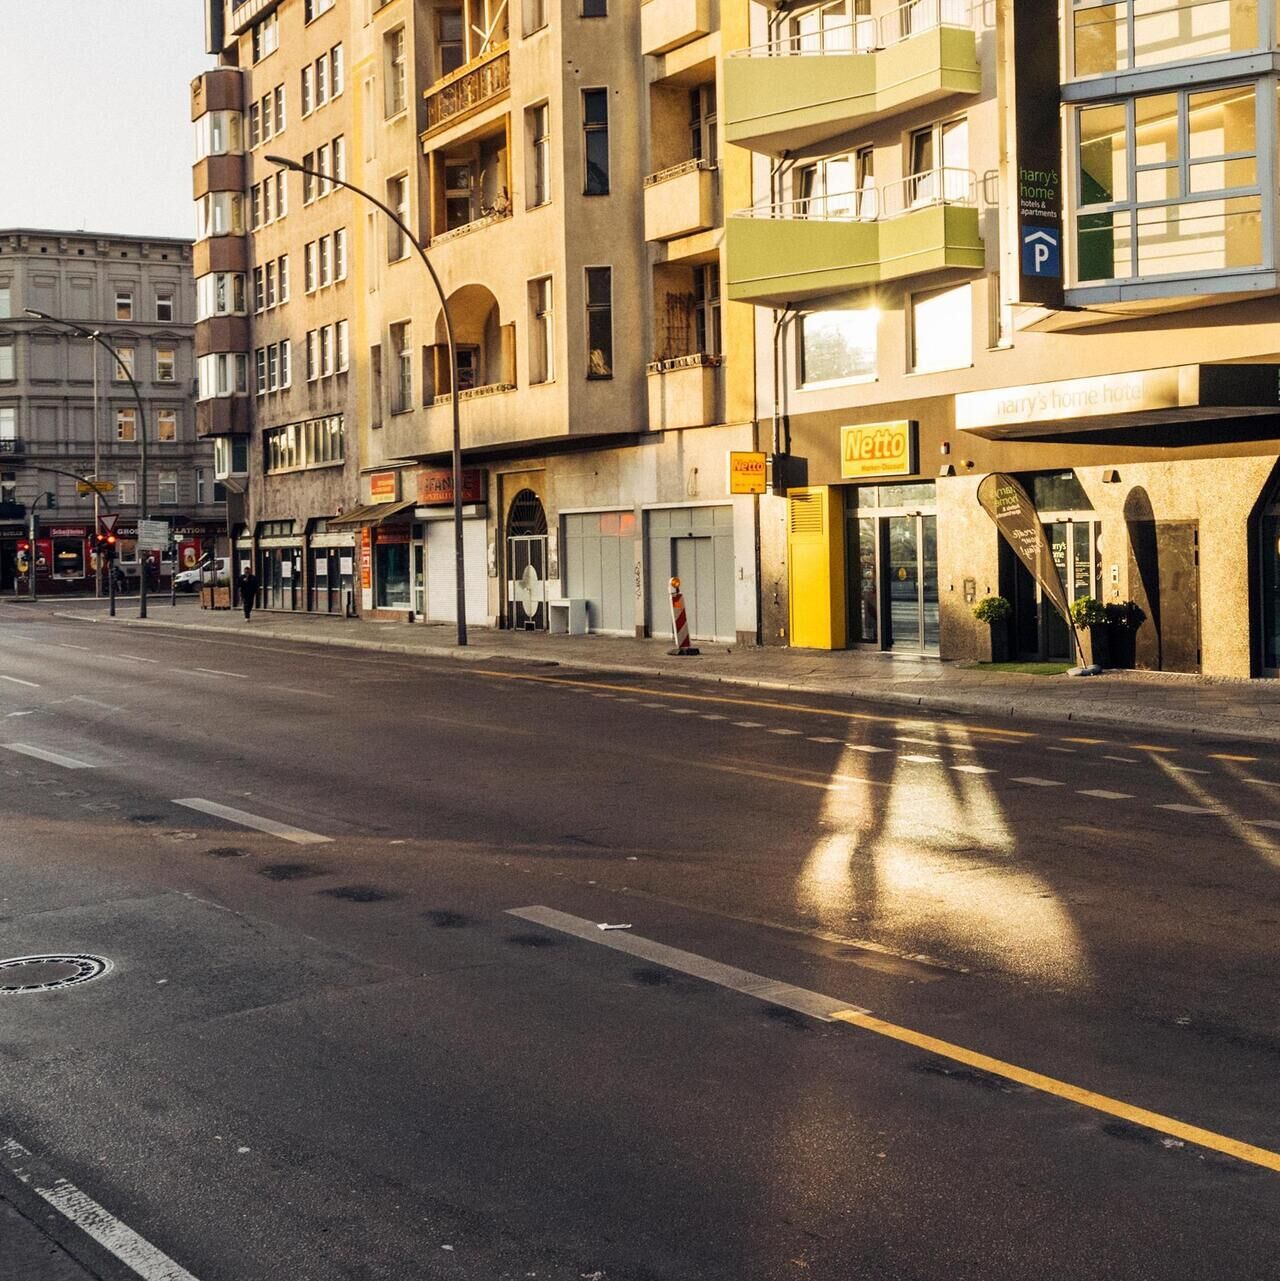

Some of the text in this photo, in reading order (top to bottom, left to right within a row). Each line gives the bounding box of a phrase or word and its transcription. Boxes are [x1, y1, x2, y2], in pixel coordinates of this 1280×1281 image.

[1020, 166, 1058, 186] harry's
[1020, 183, 1055, 200] home
[1021, 200, 1046, 209] hotels &
[1021, 208, 1057, 218] apartments
[1035, 244, 1049, 272] P
[1052, 387, 1097, 409] home
[1103, 383, 1145, 404] hotel
[845, 428, 905, 461] Netto
[733, 458, 764, 471] Netto
